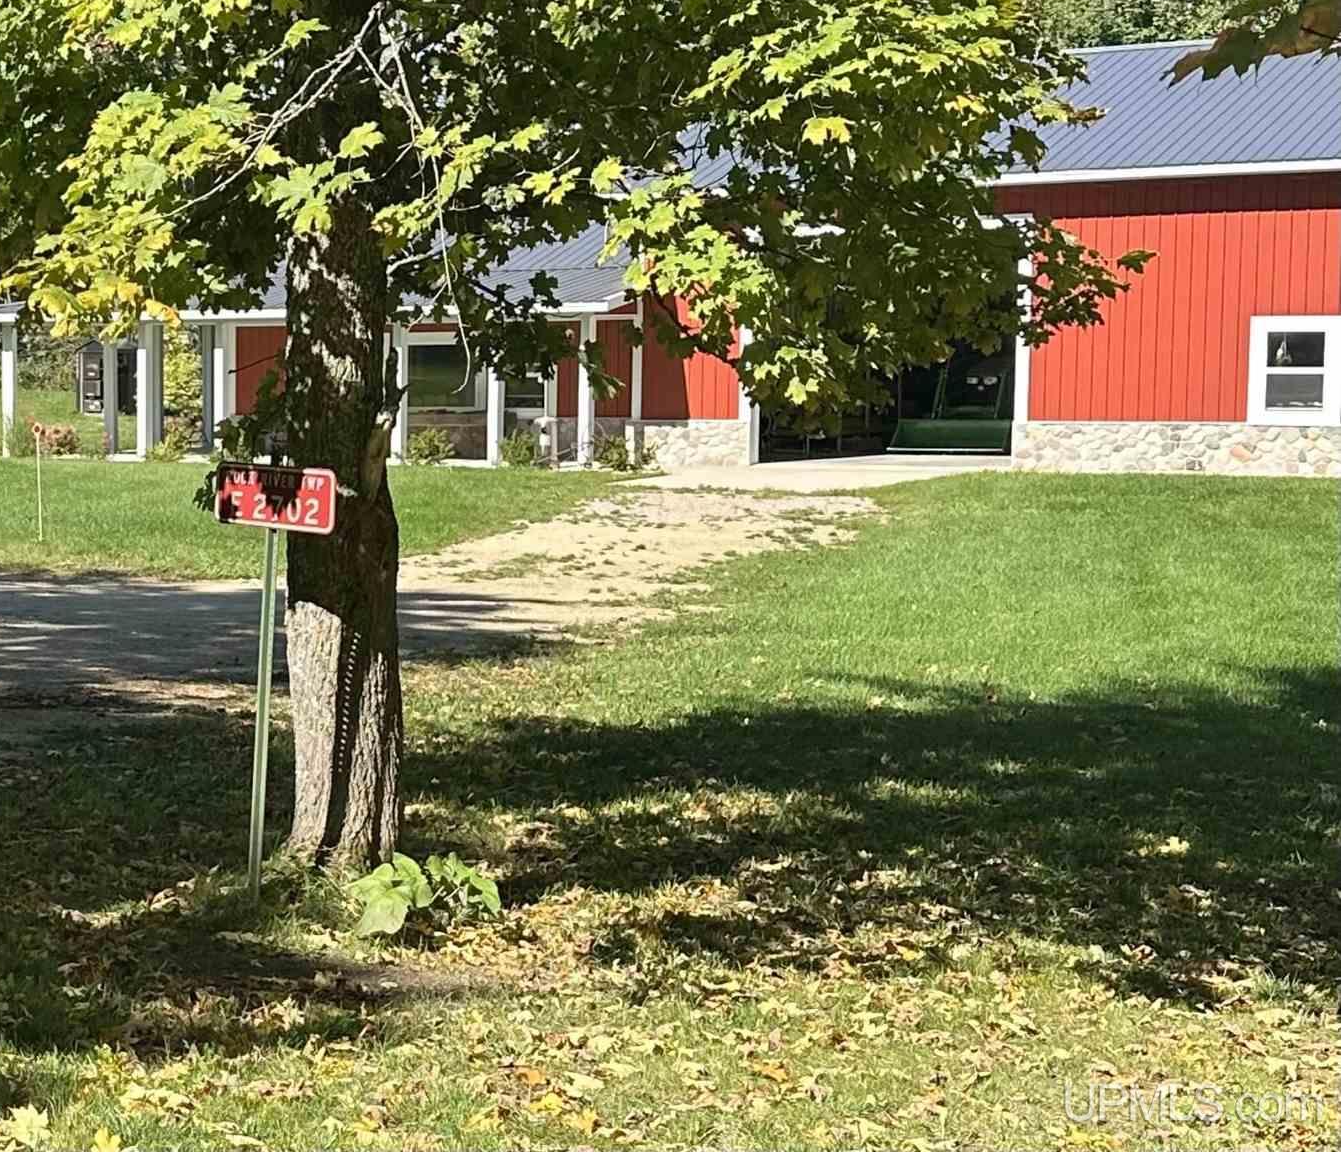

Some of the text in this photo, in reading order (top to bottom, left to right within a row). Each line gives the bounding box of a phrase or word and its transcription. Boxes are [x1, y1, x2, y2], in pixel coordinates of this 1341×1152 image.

[260, 472, 296, 489] RIVER
[301, 475, 324, 491] TWP
[230, 490, 320, 525] E 2702
